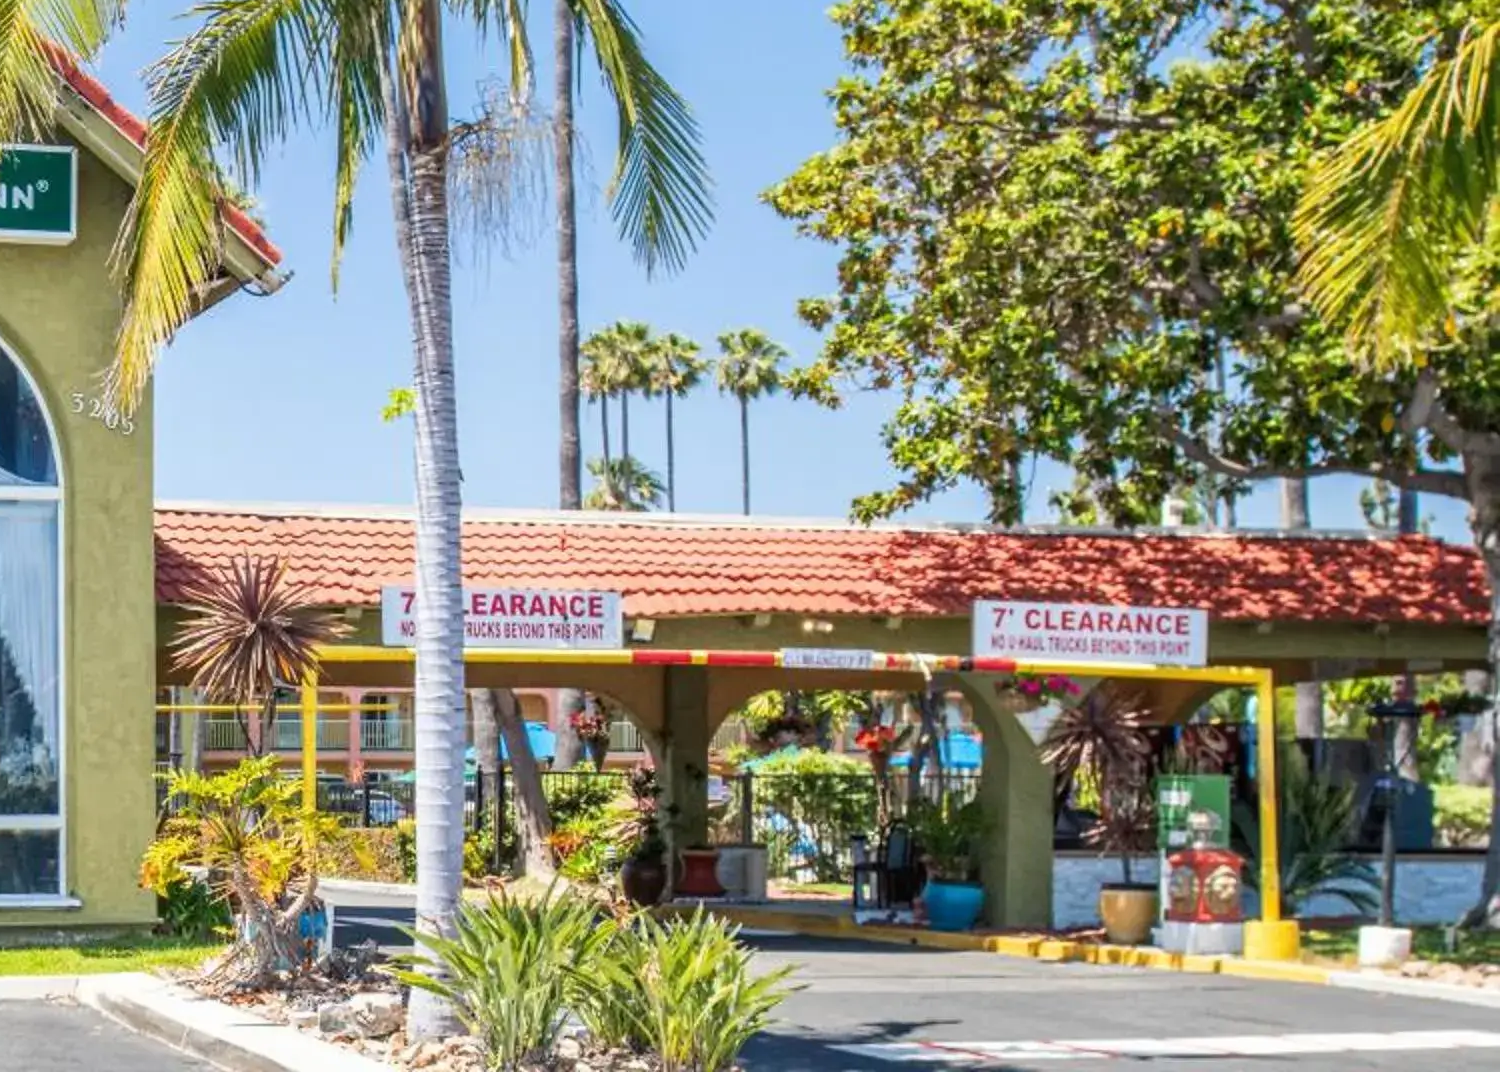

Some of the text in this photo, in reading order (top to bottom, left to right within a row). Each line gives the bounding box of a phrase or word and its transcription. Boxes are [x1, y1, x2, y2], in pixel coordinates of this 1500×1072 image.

[462, 593, 604, 618] EARANCE
[400, 620, 604, 640] NO RUCKS BEYOND THIS POINT
[1025, 609, 1190, 636] CLEARANCE
[991, 634, 1005, 650] NO
[1048, 637, 1089, 653] TRUCKS
[1091, 639, 1131, 655] BEYOND
[1133, 640, 1157, 656] THIS
[1160, 641, 1191, 657] POINT
